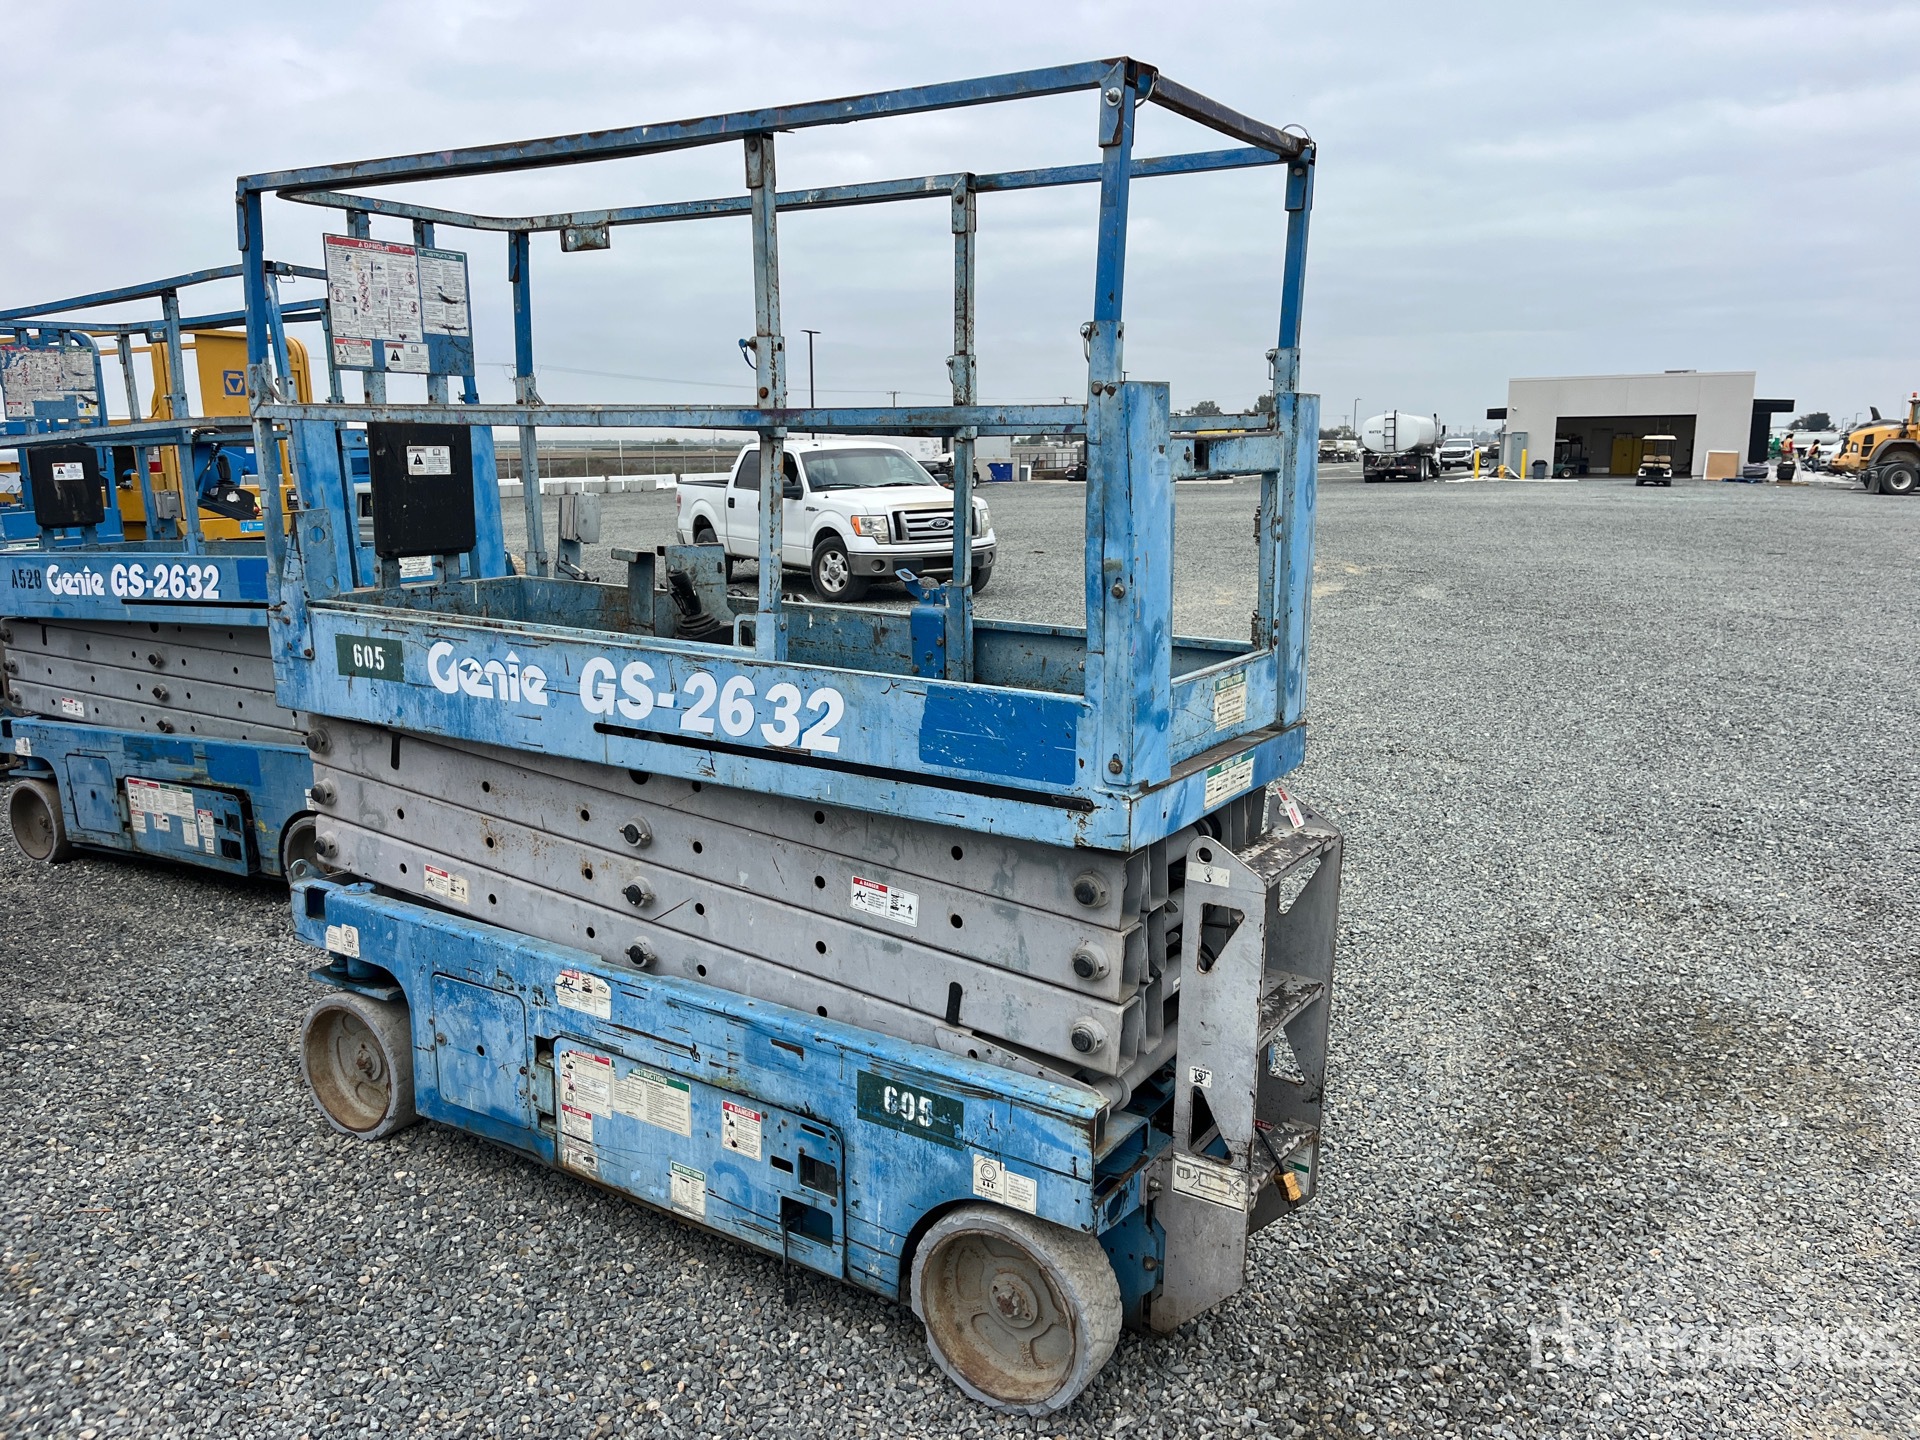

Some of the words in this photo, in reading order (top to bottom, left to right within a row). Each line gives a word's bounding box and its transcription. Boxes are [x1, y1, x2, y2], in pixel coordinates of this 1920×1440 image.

[11, 569, 42, 589] A528
[46, 564, 106, 596] Genie
[110, 563, 221, 599] GS-2632
[352, 643, 386, 671] 605
[427, 641, 549, 707] Genie
[579, 656, 846, 754] GS-2632
[632, 1067, 668, 1085] INSTRUCTIONS
[734, 1105, 756, 1119] DANGER
[883, 1085, 934, 1127] 605
